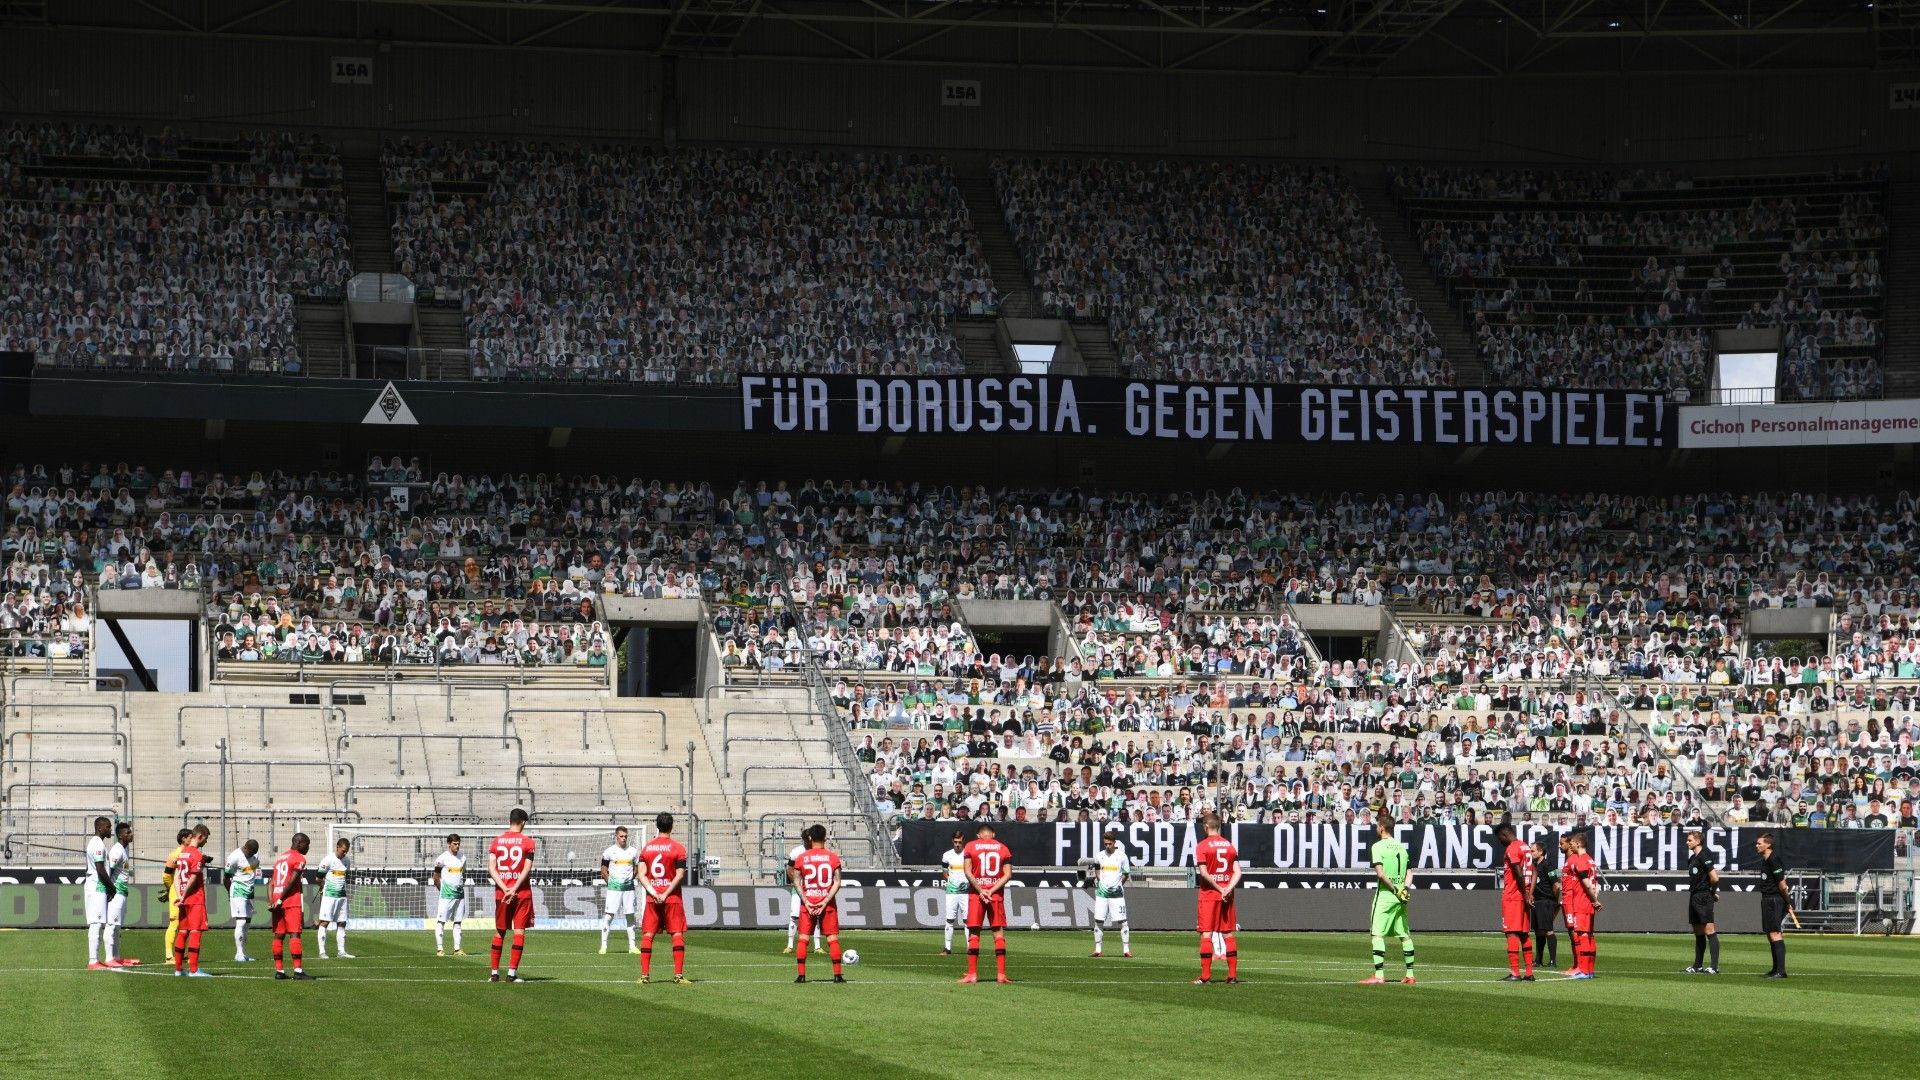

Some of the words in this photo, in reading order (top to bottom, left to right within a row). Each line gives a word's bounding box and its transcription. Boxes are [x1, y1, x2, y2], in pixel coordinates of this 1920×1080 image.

[335, 63, 369, 77] 16A
[946, 86, 976, 99] 15A
[1895, 88, 1920, 101] 14
[742, 376, 828, 431] FÜR
[856, 377, 1097, 433] BORUSSIA.
[1124, 382, 1273, 440] GEGEN
[1300, 388, 1664, 447] GEISTERSPIELE!
[1690, 418, 1745, 434] Cichon
[393, 494, 407, 504] 16
[496, 845, 523, 871] 29
[1273, 823, 1371, 869] OHNE
[275, 861, 289, 885] 19
[650, 853, 666, 878] 6
[978, 851, 1001, 877] 10
[1216, 848, 1229, 873] 5
[1395, 852, 1401, 876] 1
[803, 863, 833, 888] 20
[754, 888, 866, 926] DE
[880, 887, 1113, 927] FOLEN
